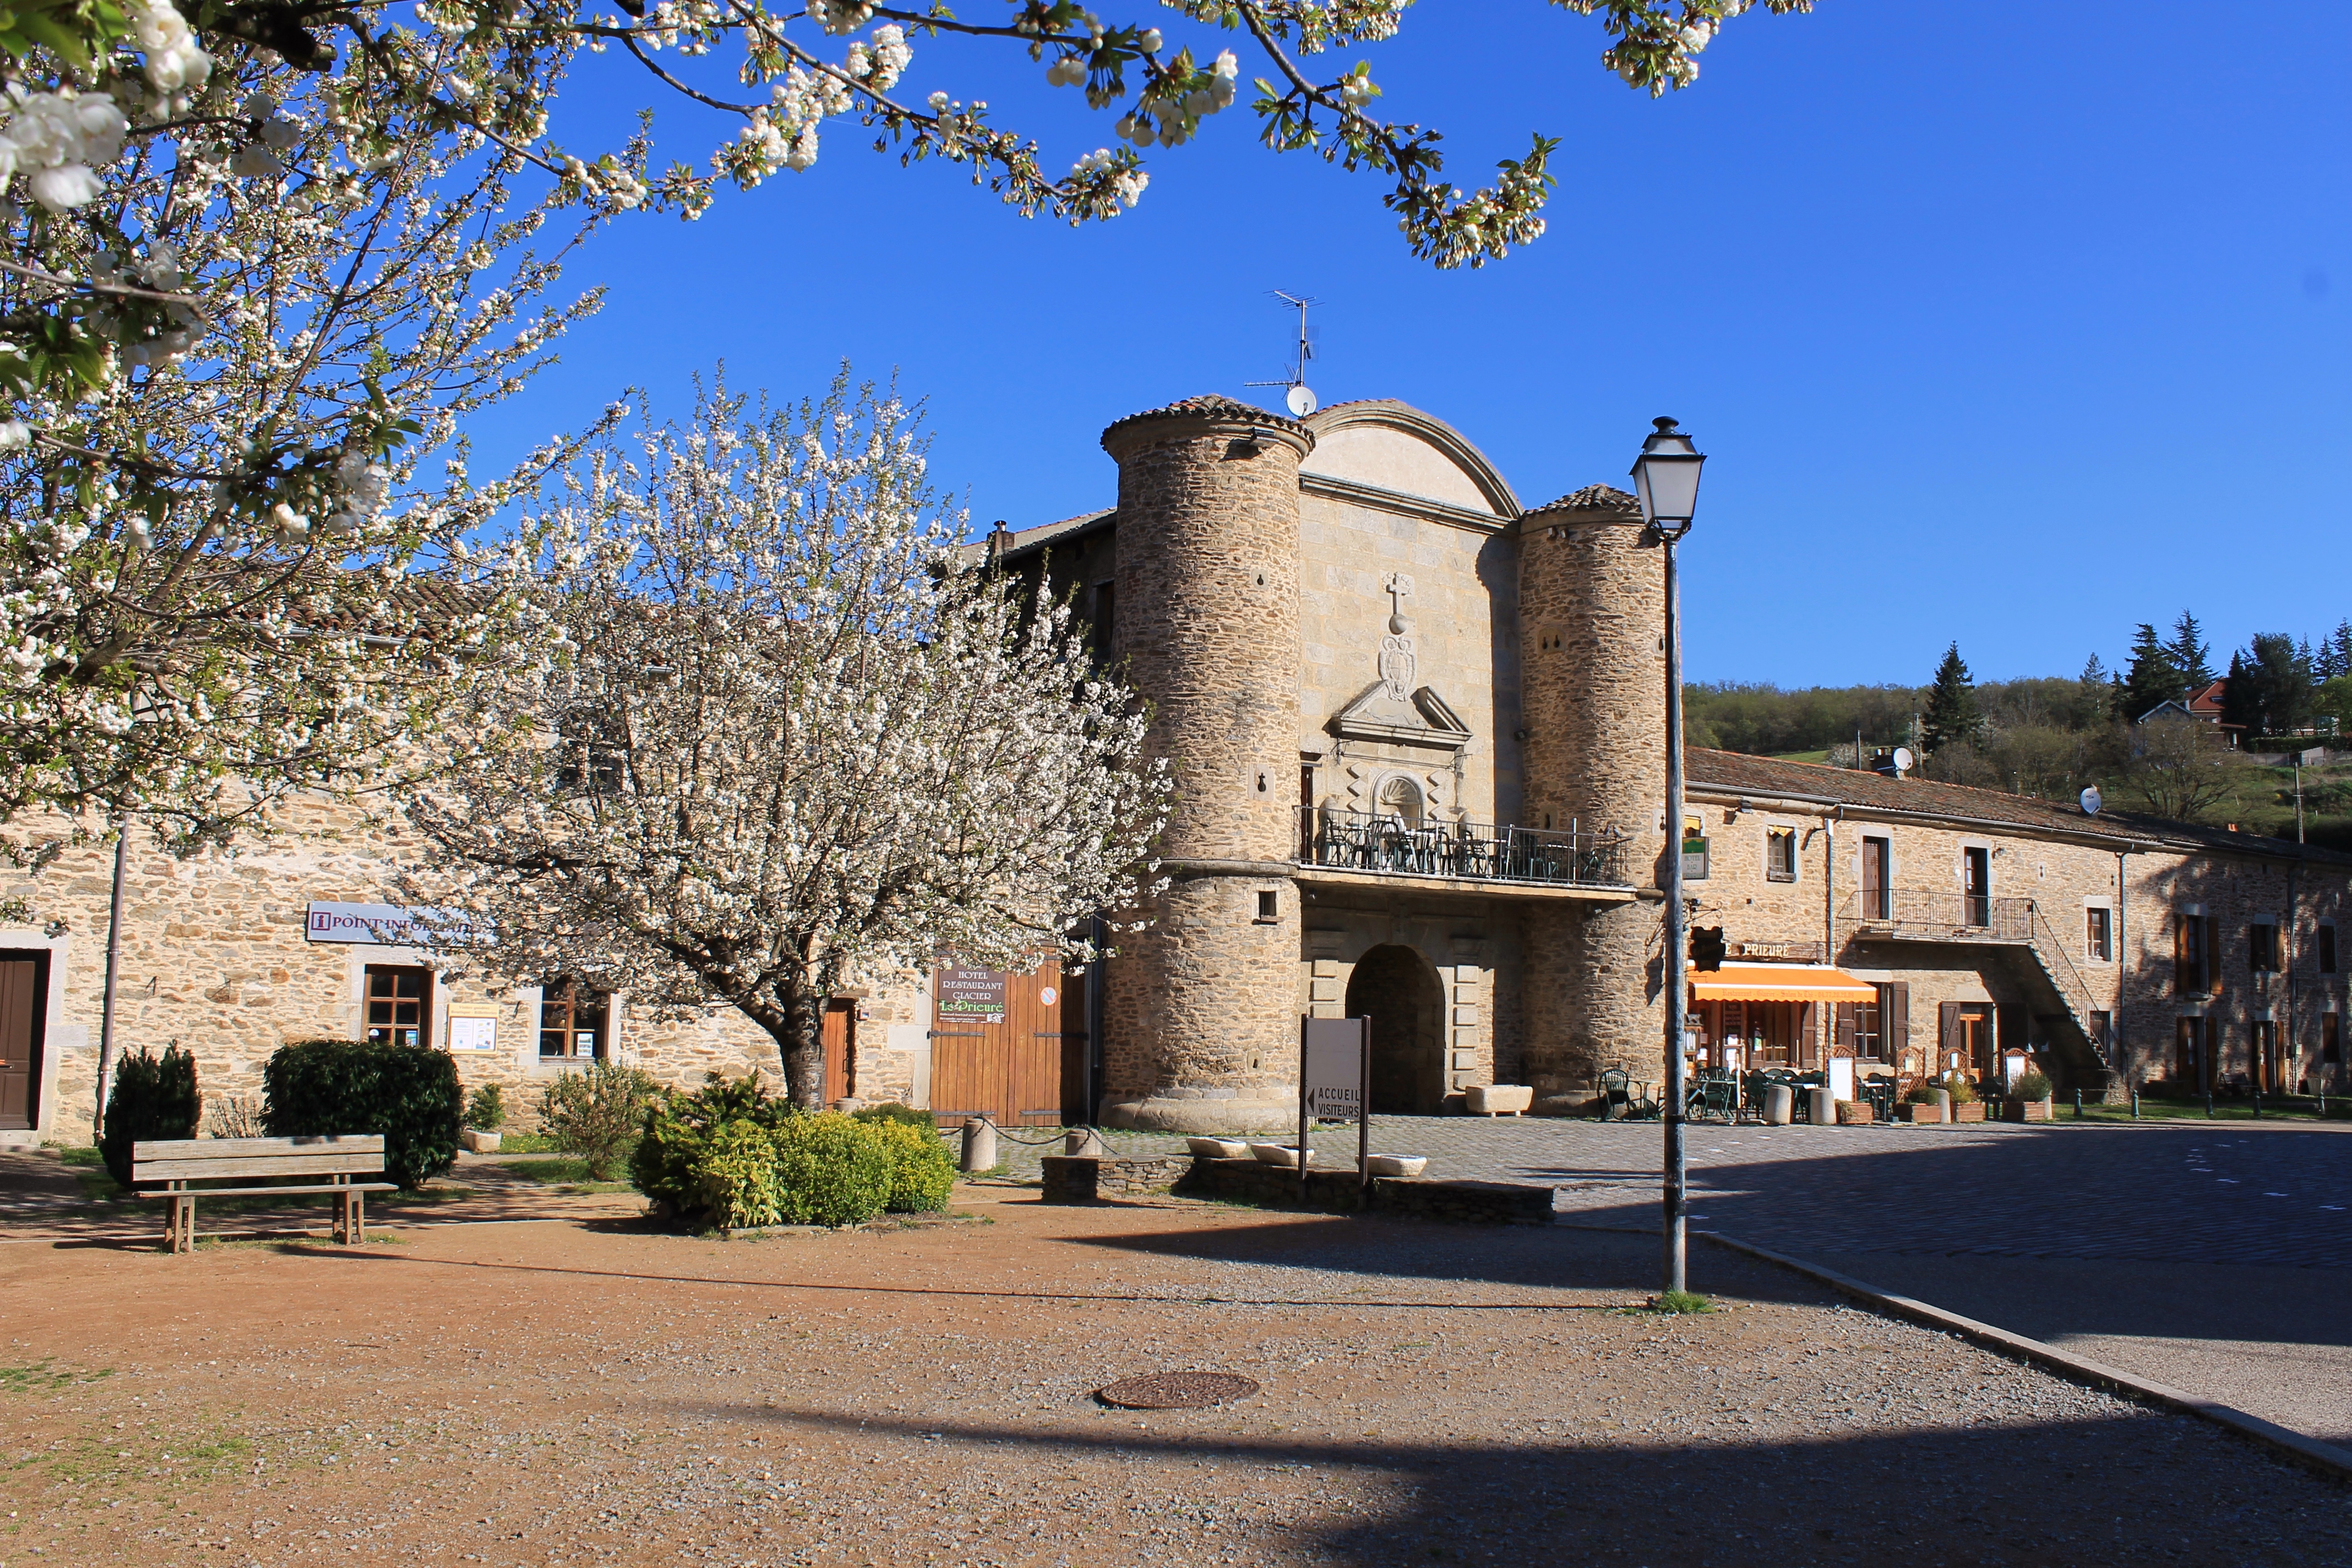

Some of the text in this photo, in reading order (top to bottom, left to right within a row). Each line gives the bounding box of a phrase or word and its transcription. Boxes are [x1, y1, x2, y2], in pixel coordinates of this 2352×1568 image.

[333, 917, 381, 929] POINT
[1742, 943, 1789, 957] PRIEURÉ
[958, 971, 988, 979] HOTEL
[943, 981, 1002, 990] RESTAURANT
[952, 992, 992, 1000] GLACIER
[958, 1000, 1004, 1012] Prieuré
[1318, 1087, 1359, 1101] ACCUEIL
[1318, 1103, 1359, 1117] VISITEURS
